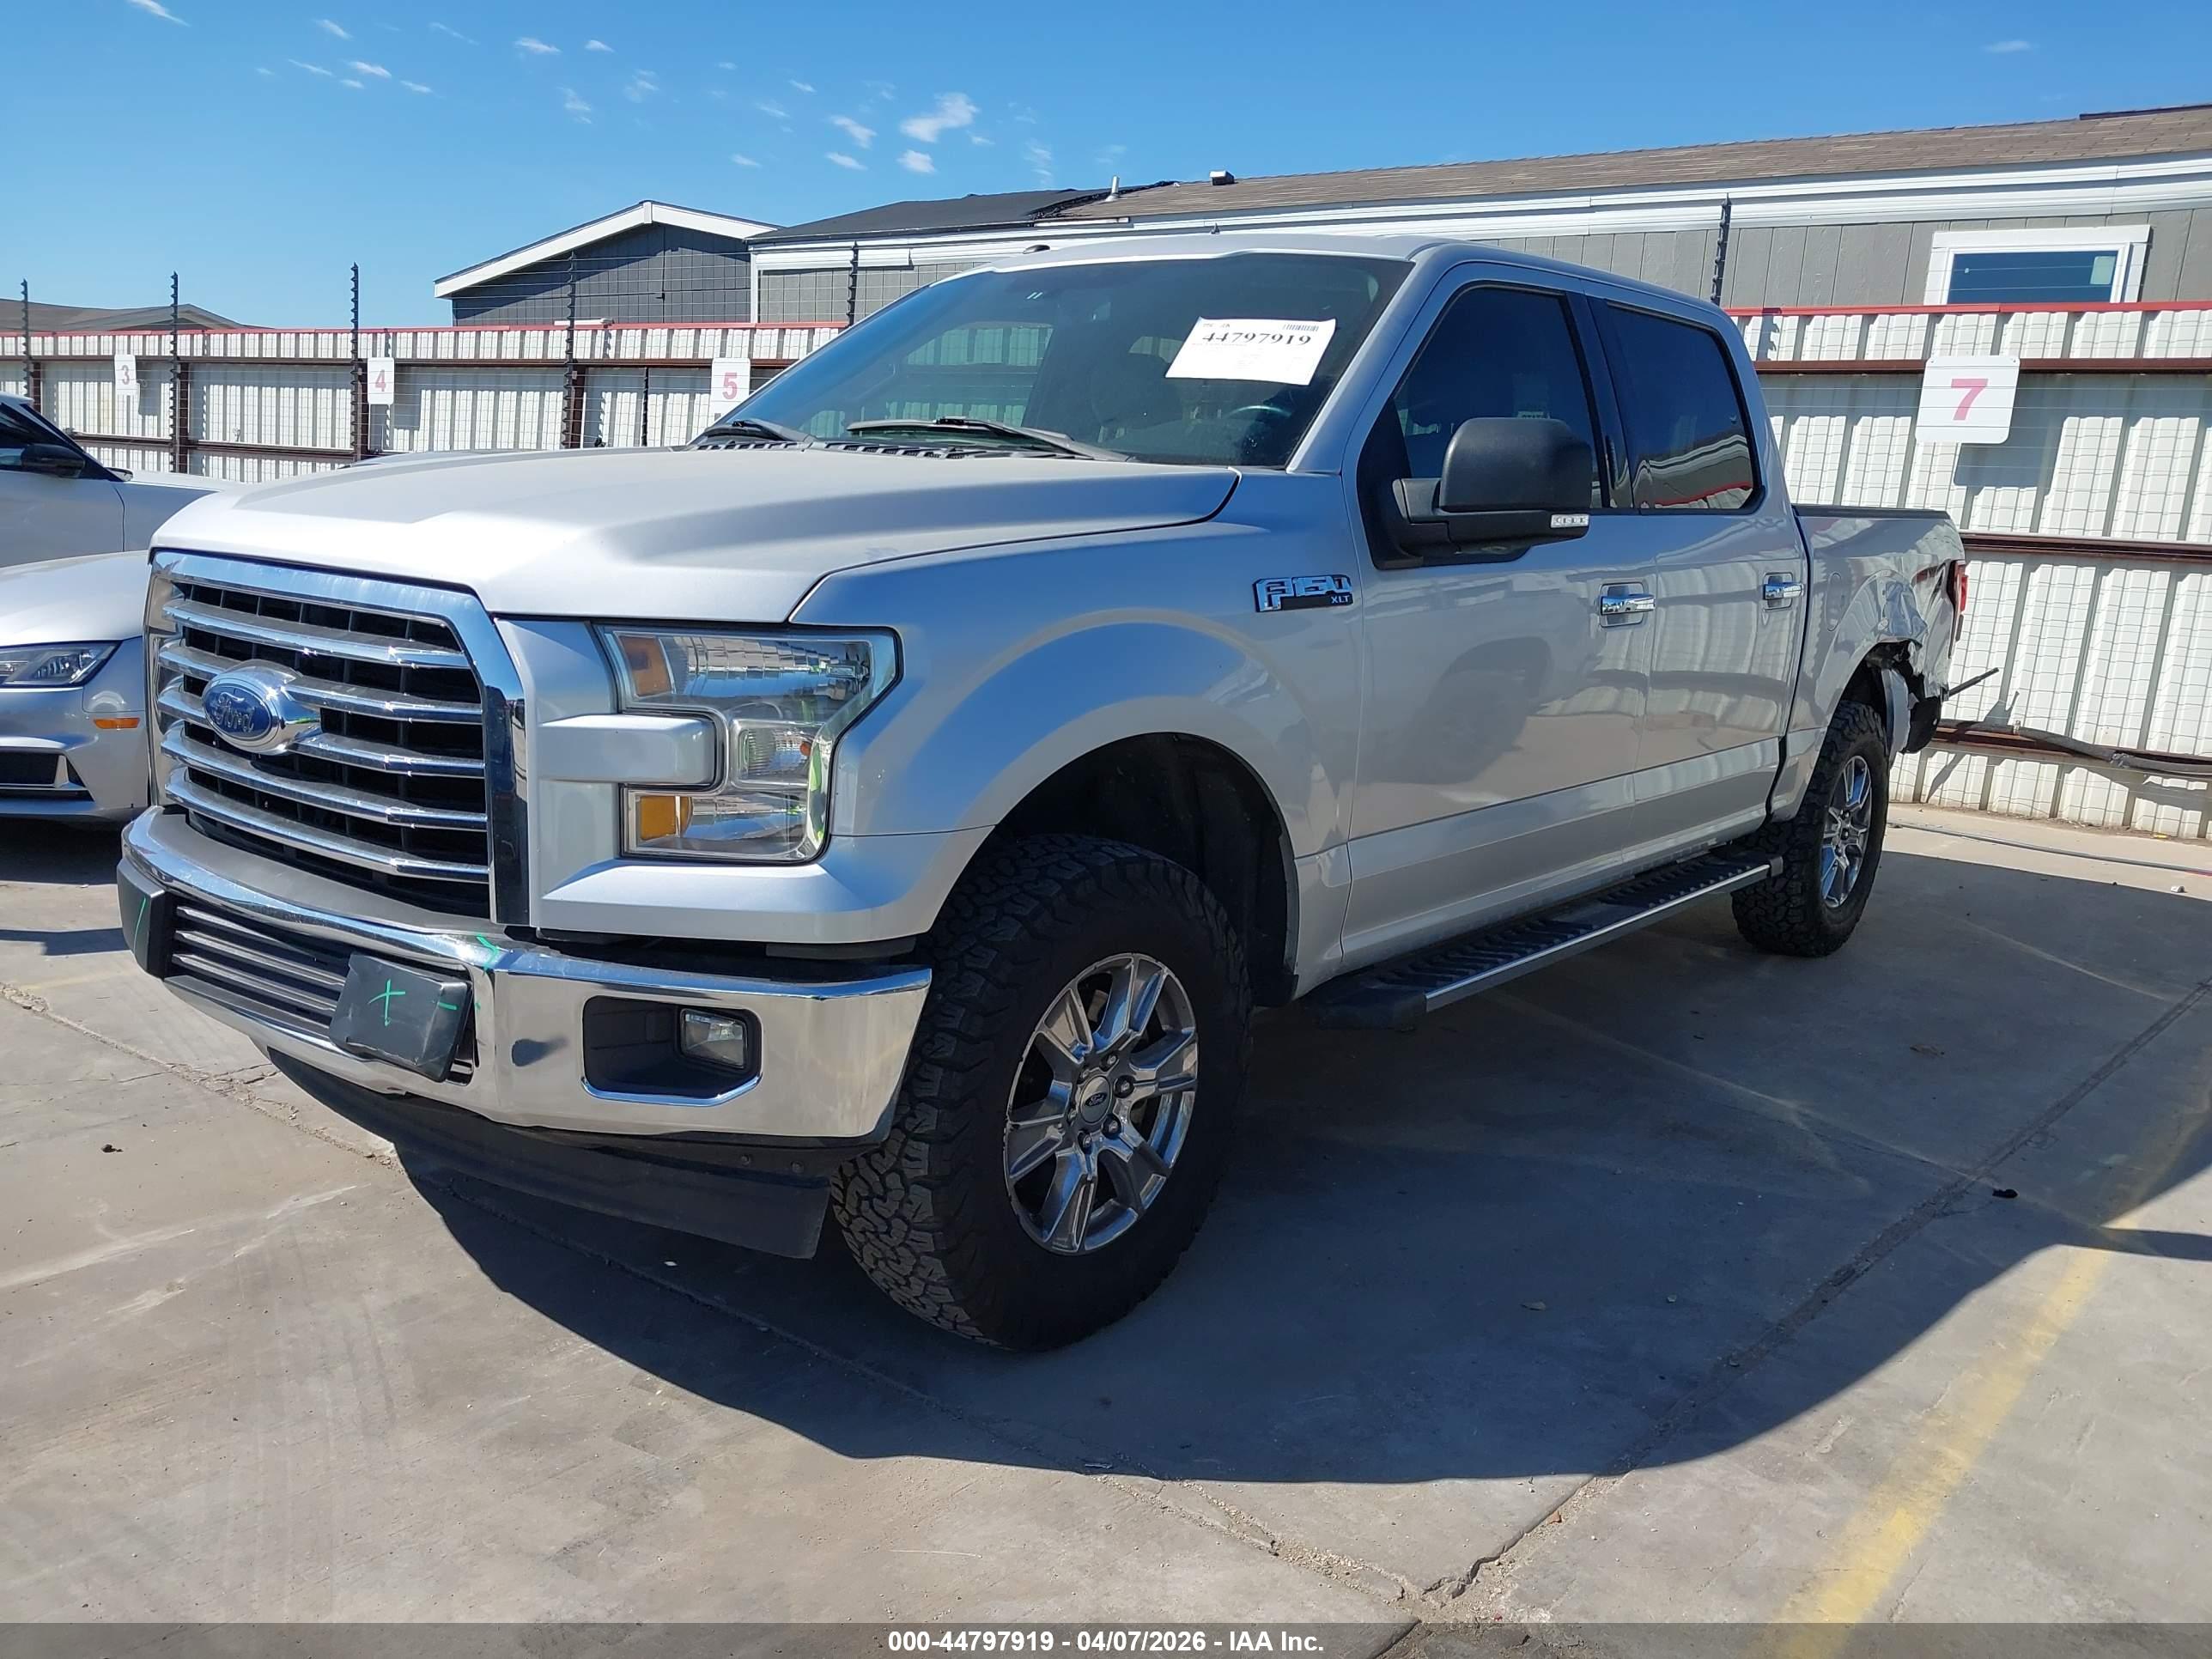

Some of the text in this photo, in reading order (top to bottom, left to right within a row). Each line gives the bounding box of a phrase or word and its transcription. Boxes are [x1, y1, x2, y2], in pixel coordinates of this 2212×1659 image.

[1201, 331, 1312, 346] 44797919
[121, 364, 131, 386] 3
[374, 369, 386, 392] 4
[722, 372, 738, 400] 5
[1950, 378, 1989, 421] 7
[1330, 595, 1350, 604] XLT
[213, 691, 258, 733] Ford
